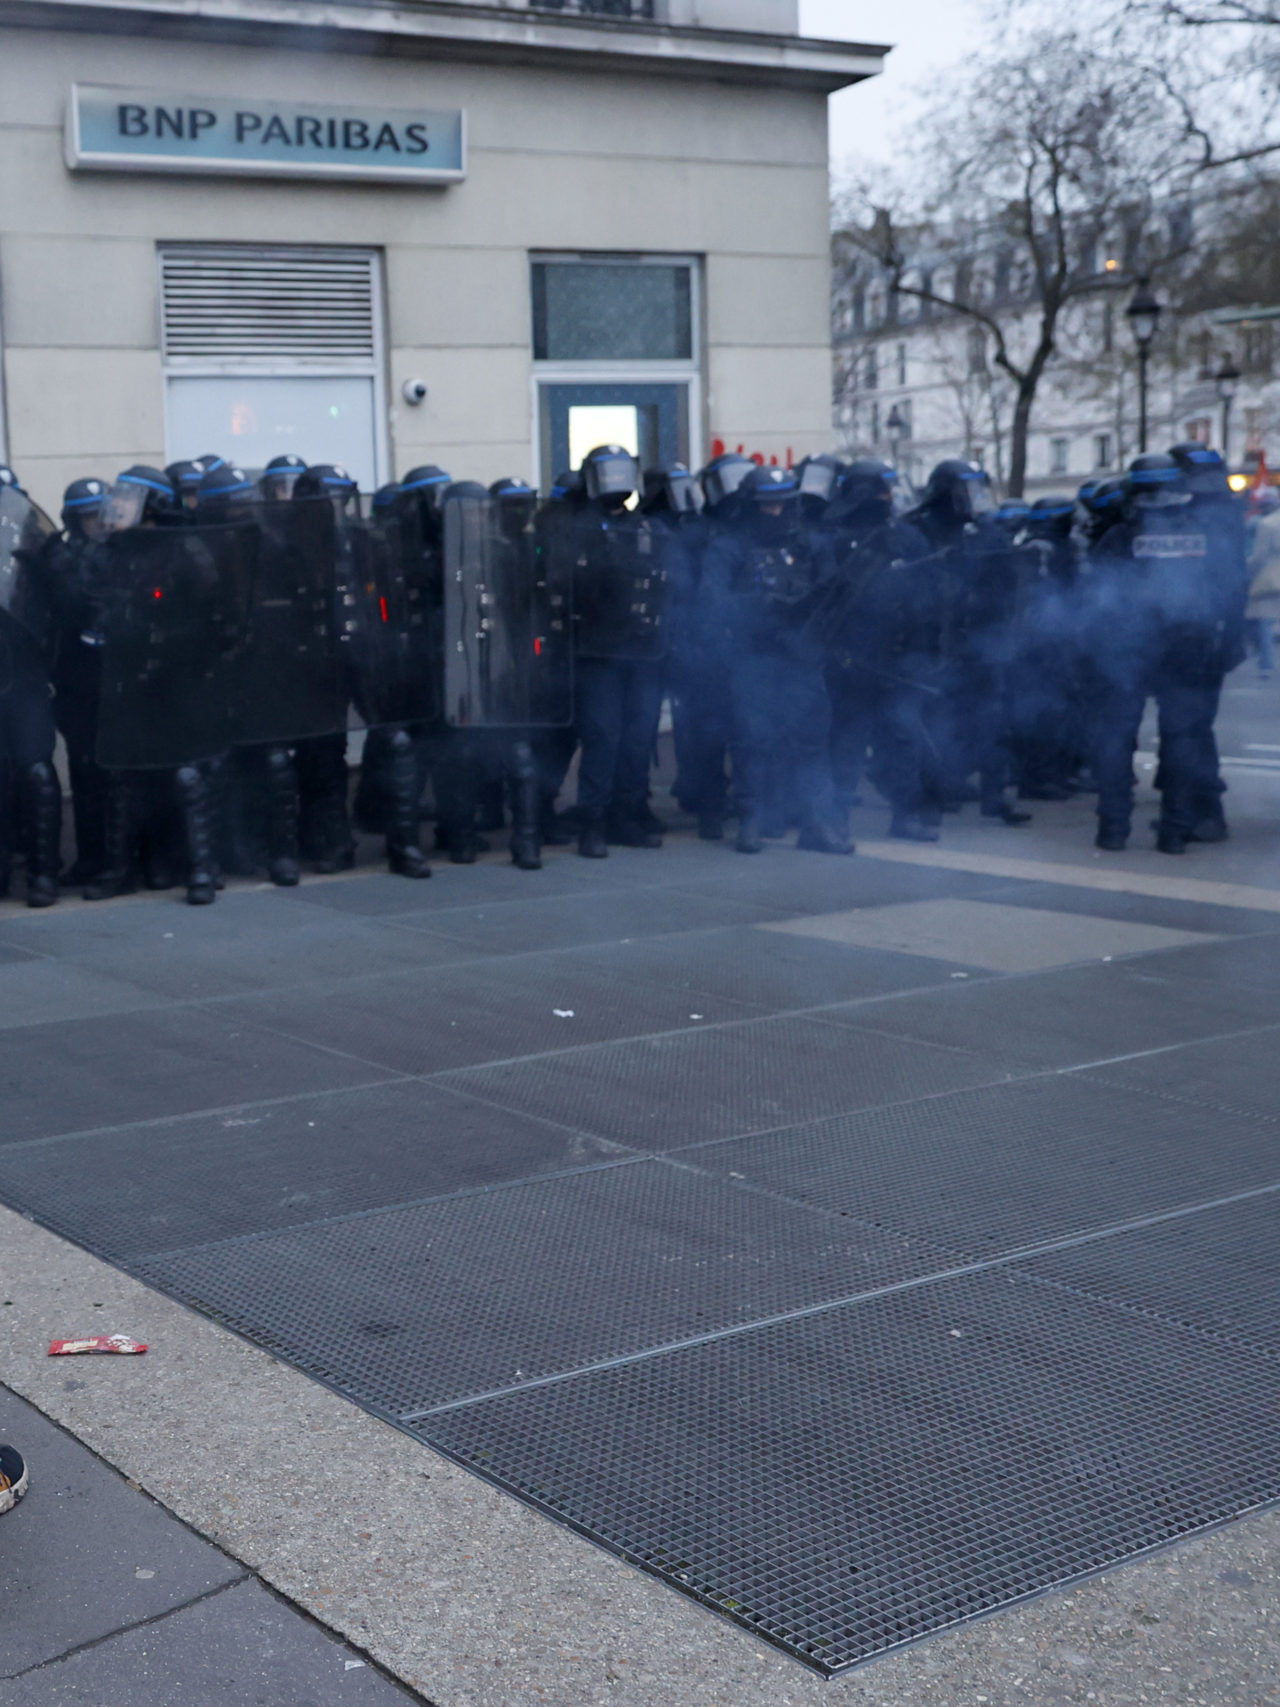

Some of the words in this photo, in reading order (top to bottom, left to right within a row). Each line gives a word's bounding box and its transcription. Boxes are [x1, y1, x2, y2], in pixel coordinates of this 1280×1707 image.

[117, 103, 217, 141] BNP
[234, 110, 429, 154] PARIBAS
[1135, 537, 1204, 552] POLICE
